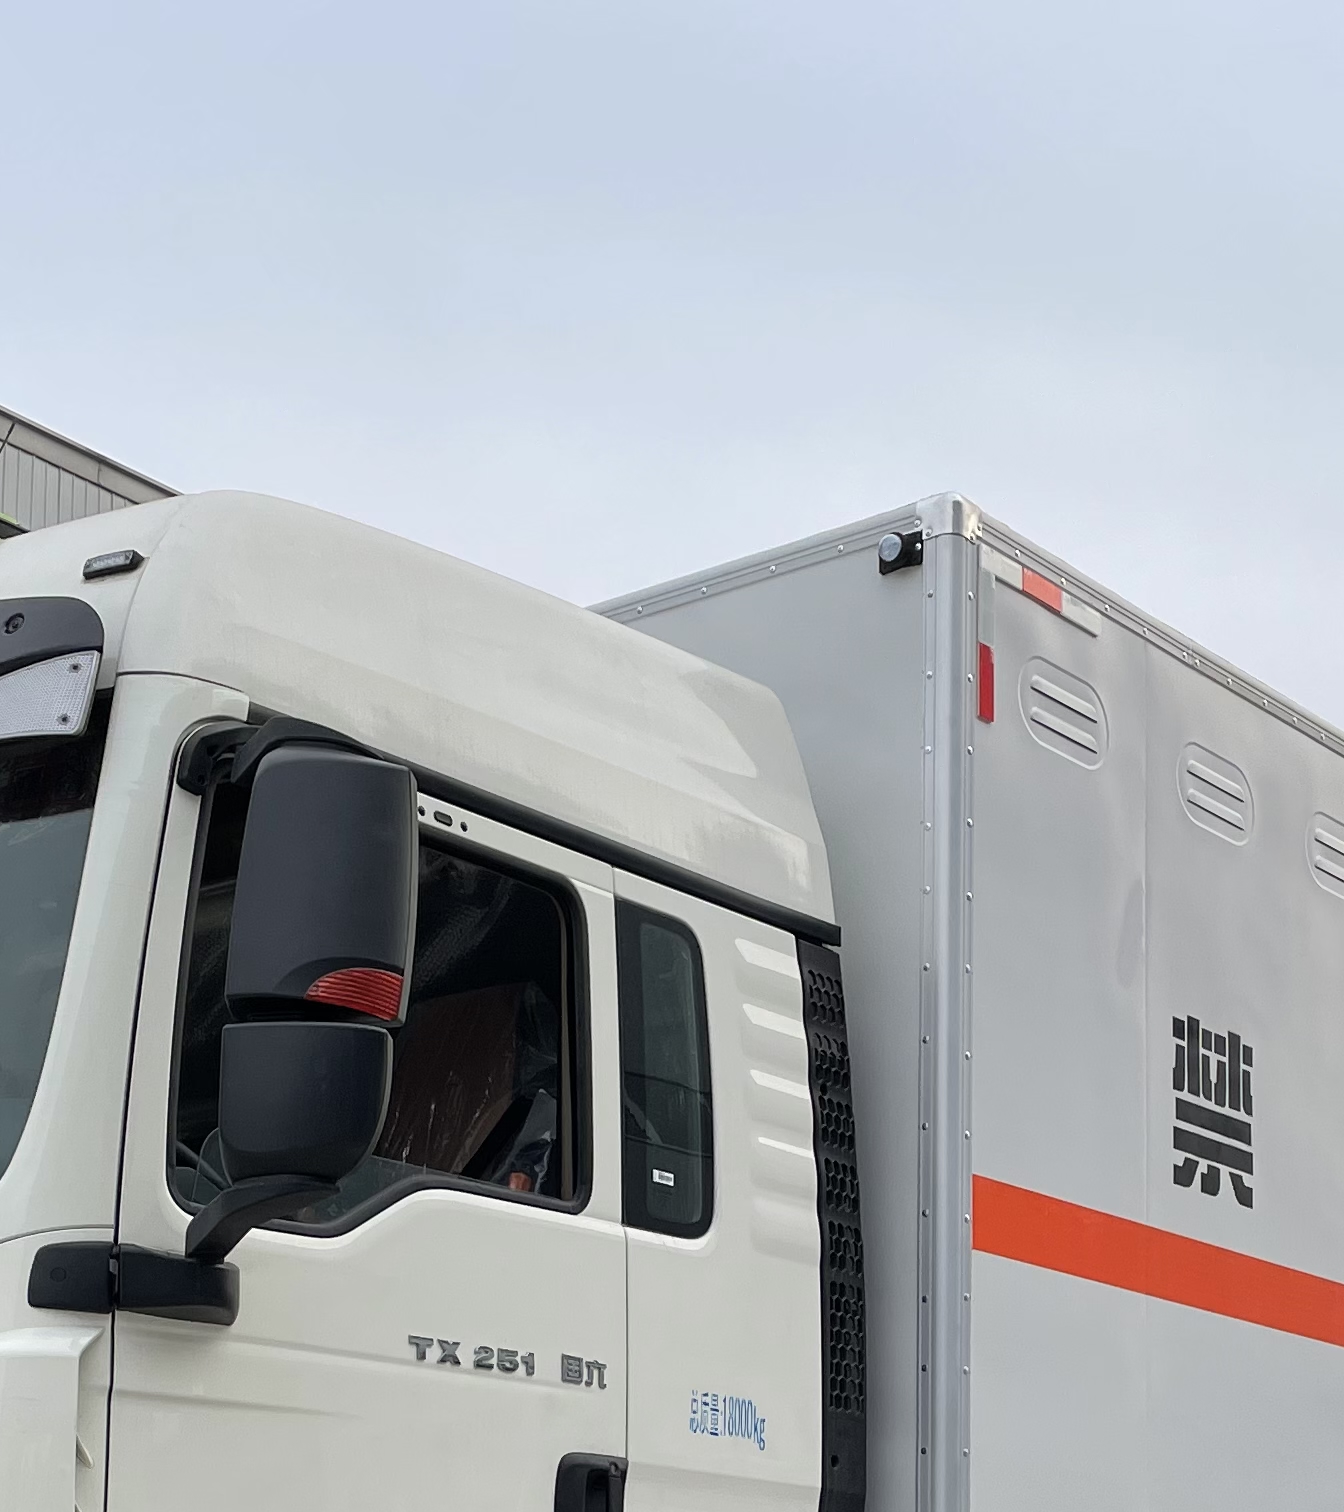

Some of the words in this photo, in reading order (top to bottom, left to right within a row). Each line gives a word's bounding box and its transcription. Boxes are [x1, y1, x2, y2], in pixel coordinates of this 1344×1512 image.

[408, 1334, 461, 1366] TX
[473, 1345, 535, 1376] 251
[560, 1352, 608, 1390] 国六
